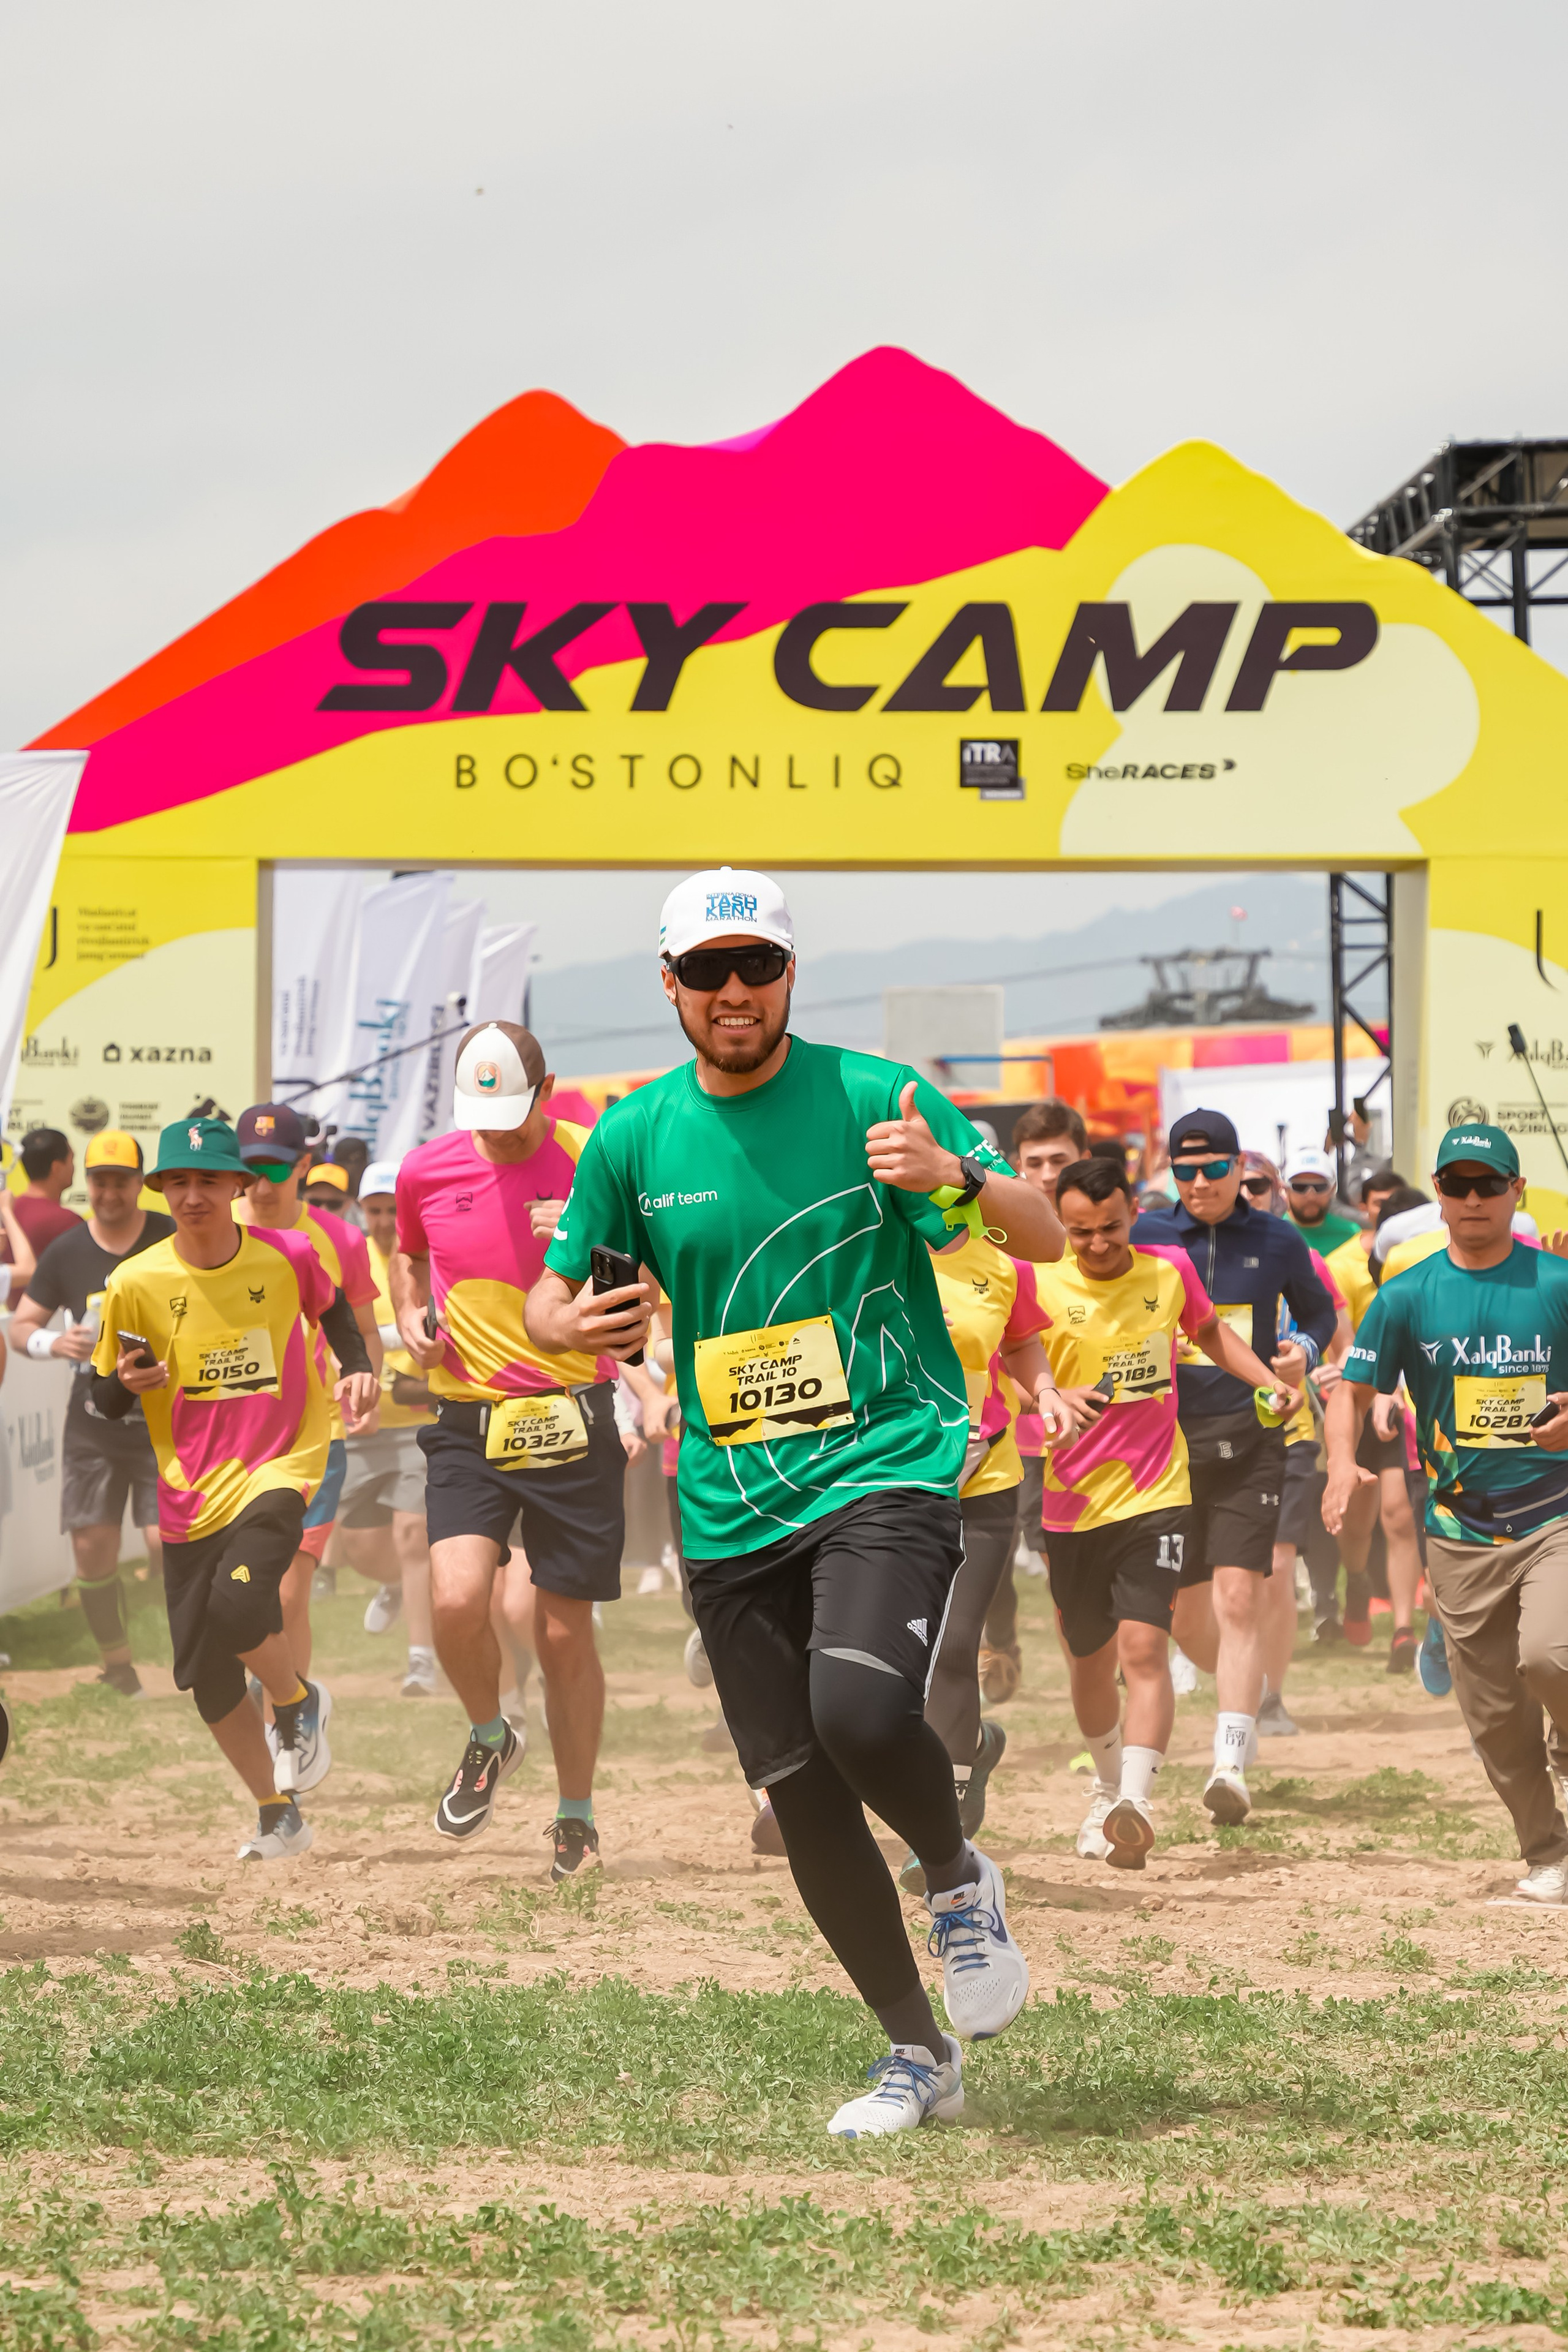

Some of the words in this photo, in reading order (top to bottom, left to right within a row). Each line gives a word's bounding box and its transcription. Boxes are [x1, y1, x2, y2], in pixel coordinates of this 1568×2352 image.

[315, 601, 750, 712] SKY
[774, 601, 1379, 712] CAMP
[1066, 763, 1216, 779] SheRACES
[706, 903, 753, 917] KENT
[707, 894, 757, 910] TASH
[130, 1046, 212, 1062] xazna
[653, 1193, 675, 1208] alif
[677, 1190, 718, 1205] team
[221, 1348, 248, 1357] CAMP
[1125, 1351, 1150, 1360] CAMP
[1451, 1334, 1551, 1370] XalqBanki
[198, 1362, 260, 1381] 10150
[729, 1363, 756, 1377] SKY
[760, 1354, 802, 1371] CAMP
[1102, 1365, 1158, 1383] 0189
[1499, 1365, 1529, 1374] since
[736, 1371, 777, 1386] TRAIL
[782, 1366, 797, 1378] 10
[729, 1378, 823, 1414] 10130
[530, 1415, 559, 1425] CAMP
[1469, 1413, 1537, 1428] 10287
[503, 1429, 575, 1452] 10327
[1156, 1533, 1185, 1573] 13
